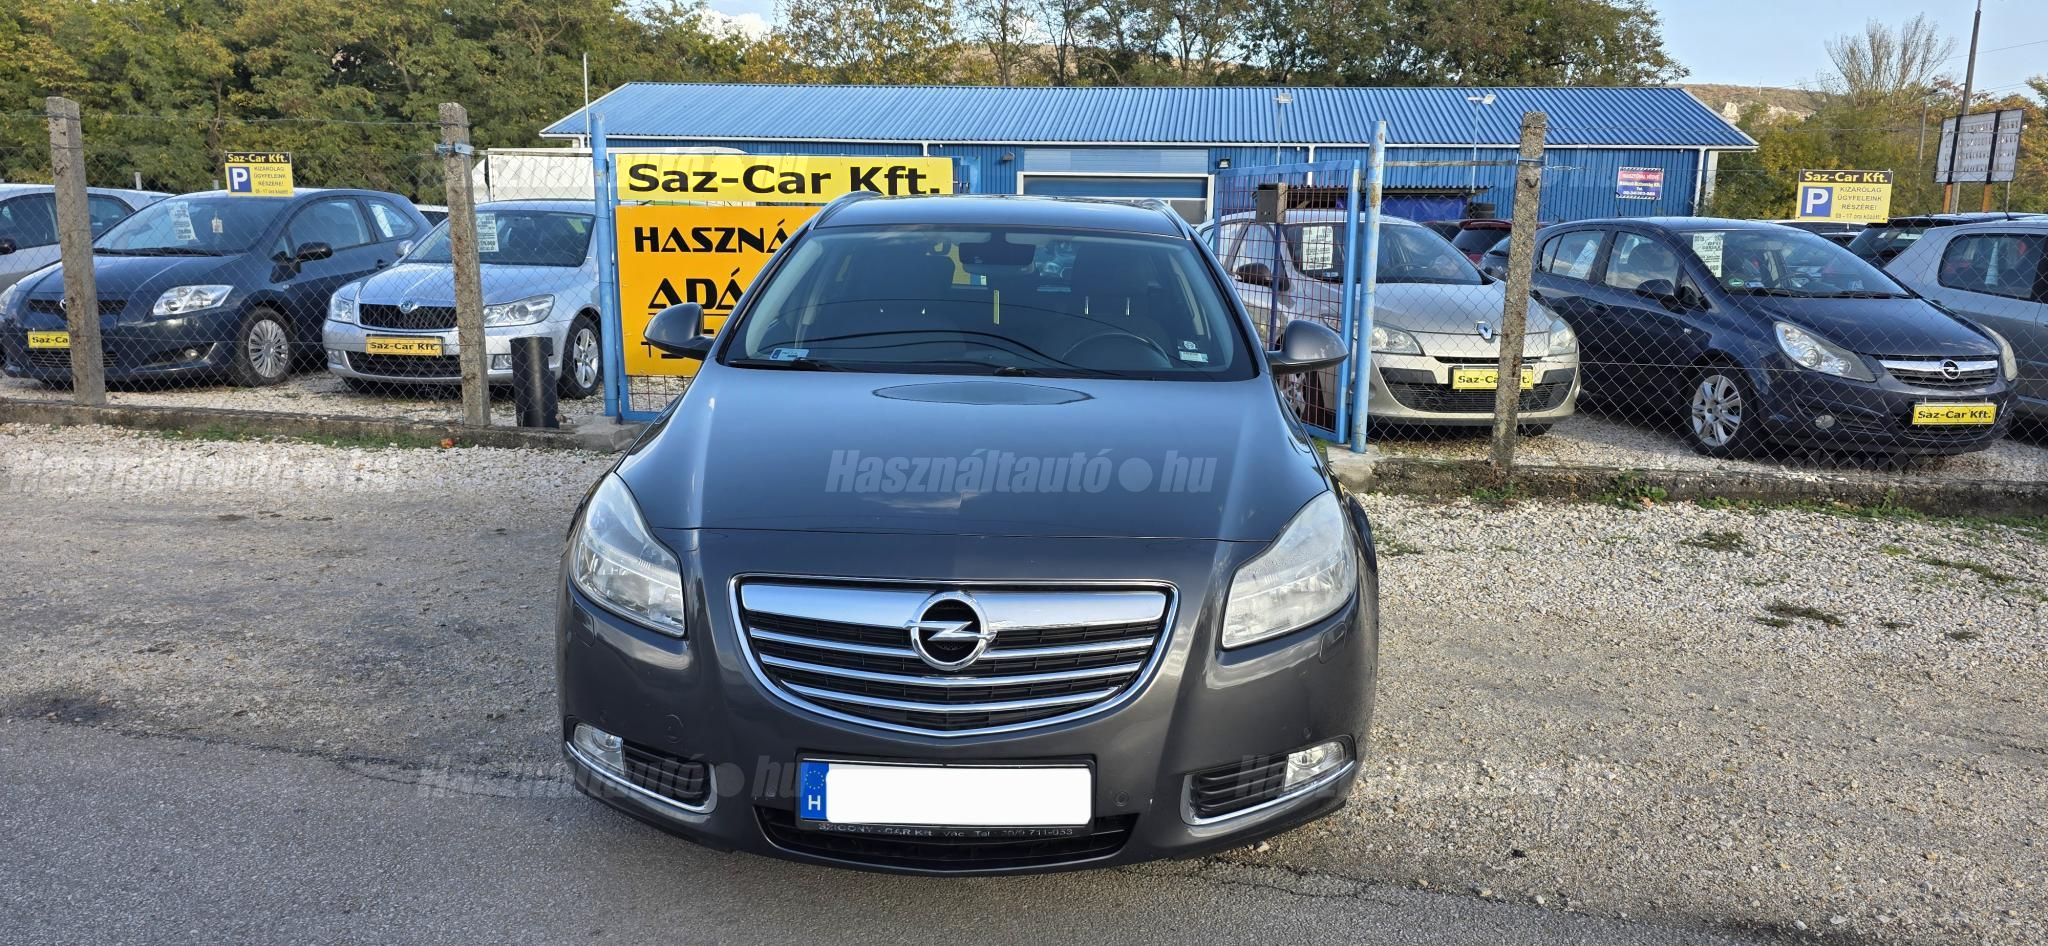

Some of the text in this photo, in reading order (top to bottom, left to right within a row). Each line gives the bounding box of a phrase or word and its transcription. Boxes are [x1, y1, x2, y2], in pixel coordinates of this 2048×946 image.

[228, 154, 288, 162] Saz-Car Kft.
[628, 164, 831, 194] Saz-Car
[850, 166, 941, 195] Kft.
[1804, 172, 1888, 182] Saz-Car Kft.
[634, 218, 789, 253] HASZNÁ
[648, 267, 746, 310] ADÁ
[32, 336, 68, 344] Saz-Ca
[371, 342, 414, 350] Saz-Car
[808, 794, 821, 811] H
